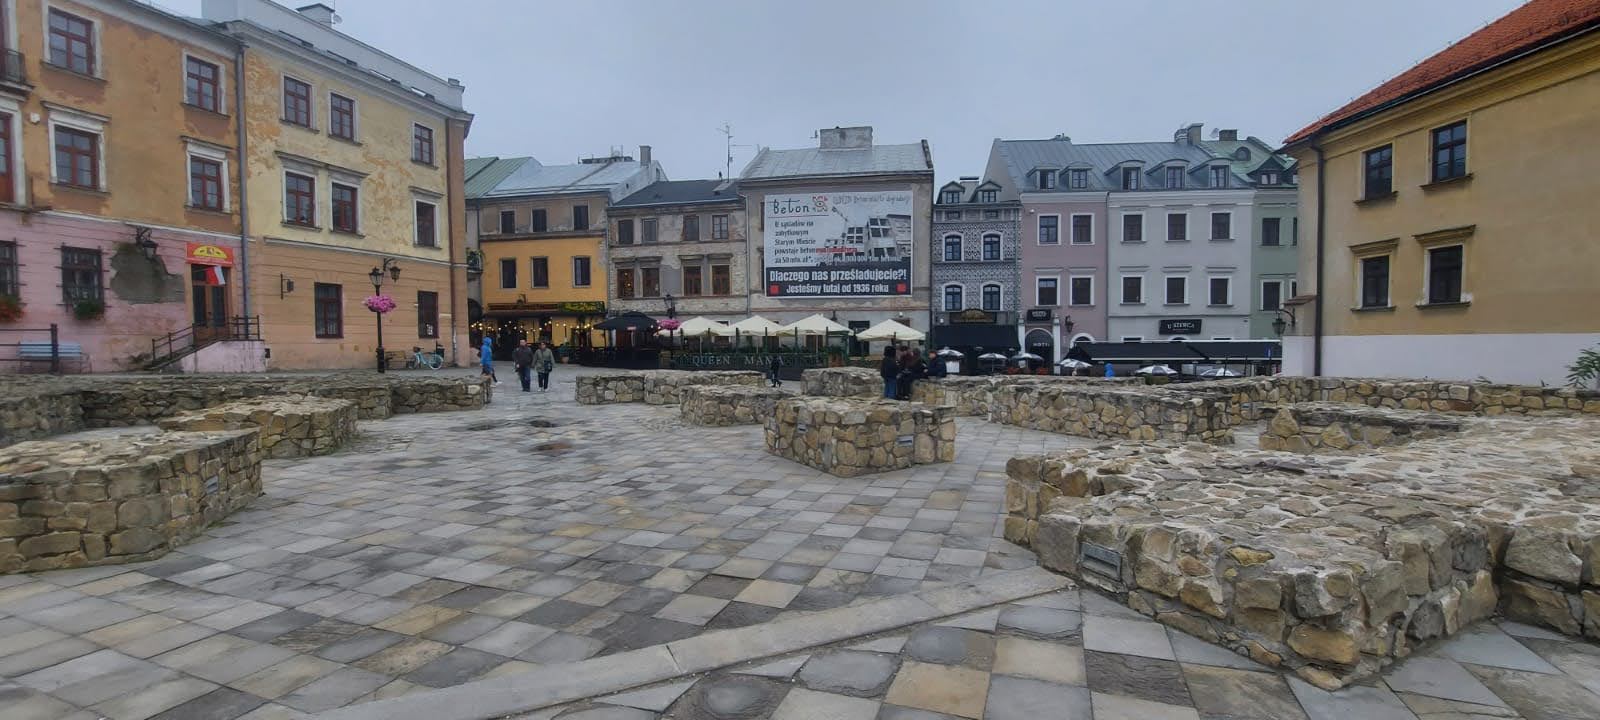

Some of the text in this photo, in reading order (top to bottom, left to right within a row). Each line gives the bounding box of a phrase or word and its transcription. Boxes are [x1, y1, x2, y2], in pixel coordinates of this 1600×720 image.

[769, 268, 907, 282] Dlaczego nas prześladujecie?!
[786, 283, 889, 294] Jesteśmy tutaj od 1936 roku
[692, 355, 731, 367] QUEEN
